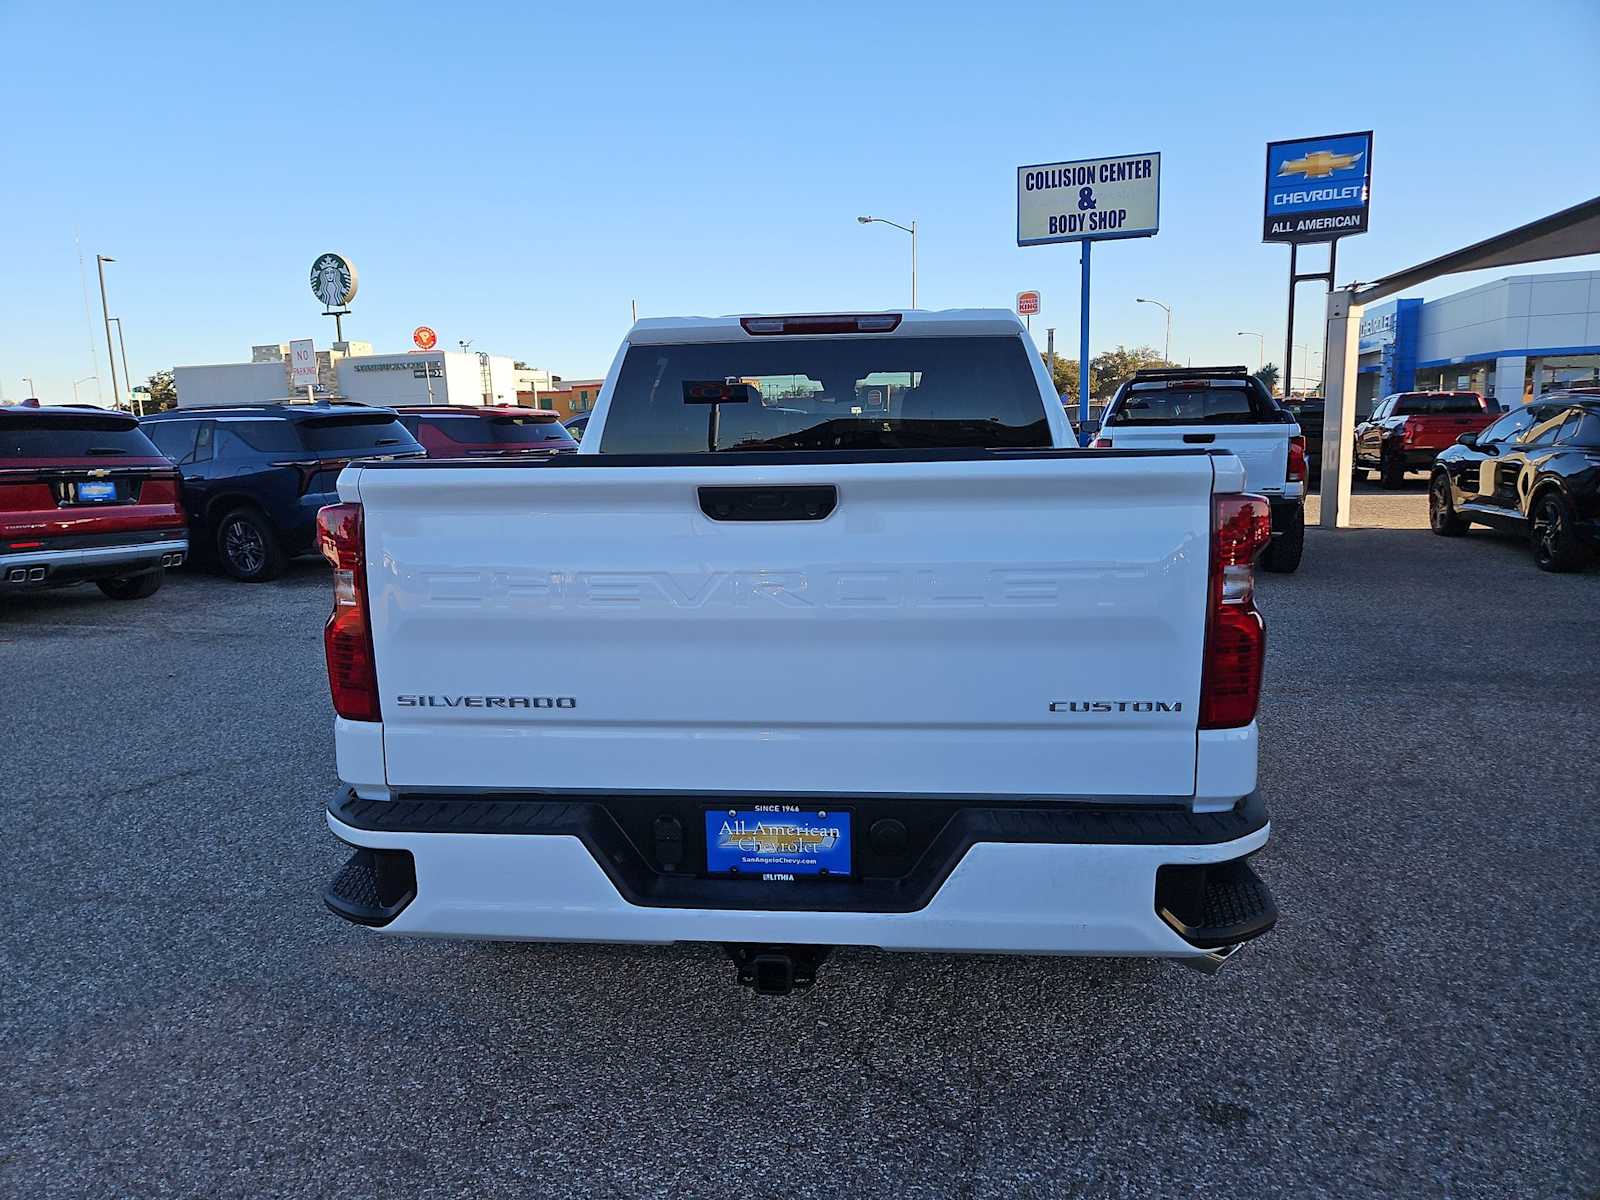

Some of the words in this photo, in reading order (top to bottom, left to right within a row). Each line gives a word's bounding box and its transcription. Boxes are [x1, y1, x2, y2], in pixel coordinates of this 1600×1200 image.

[1025, 165, 1096, 191] COLLISION
[1099, 159, 1152, 183] CENTER
[1078, 186, 1097, 210] &
[1273, 186, 1361, 206] CHEVROLET
[1049, 213, 1085, 234] BODY
[1089, 209, 1127, 231] SHOP
[1271, 221, 1294, 234] ALL
[1296, 215, 1361, 231] AMERICAN
[296, 350, 309, 361] NO
[397, 695, 577, 709] SILVERADO
[1049, 701, 1182, 712] CUSTOM
[719, 820, 745, 836] All
[752, 821, 840, 838] American
[738, 836, 820, 854] Chevrolet
[742, 856, 817, 865] SanAngeloChevy.com
